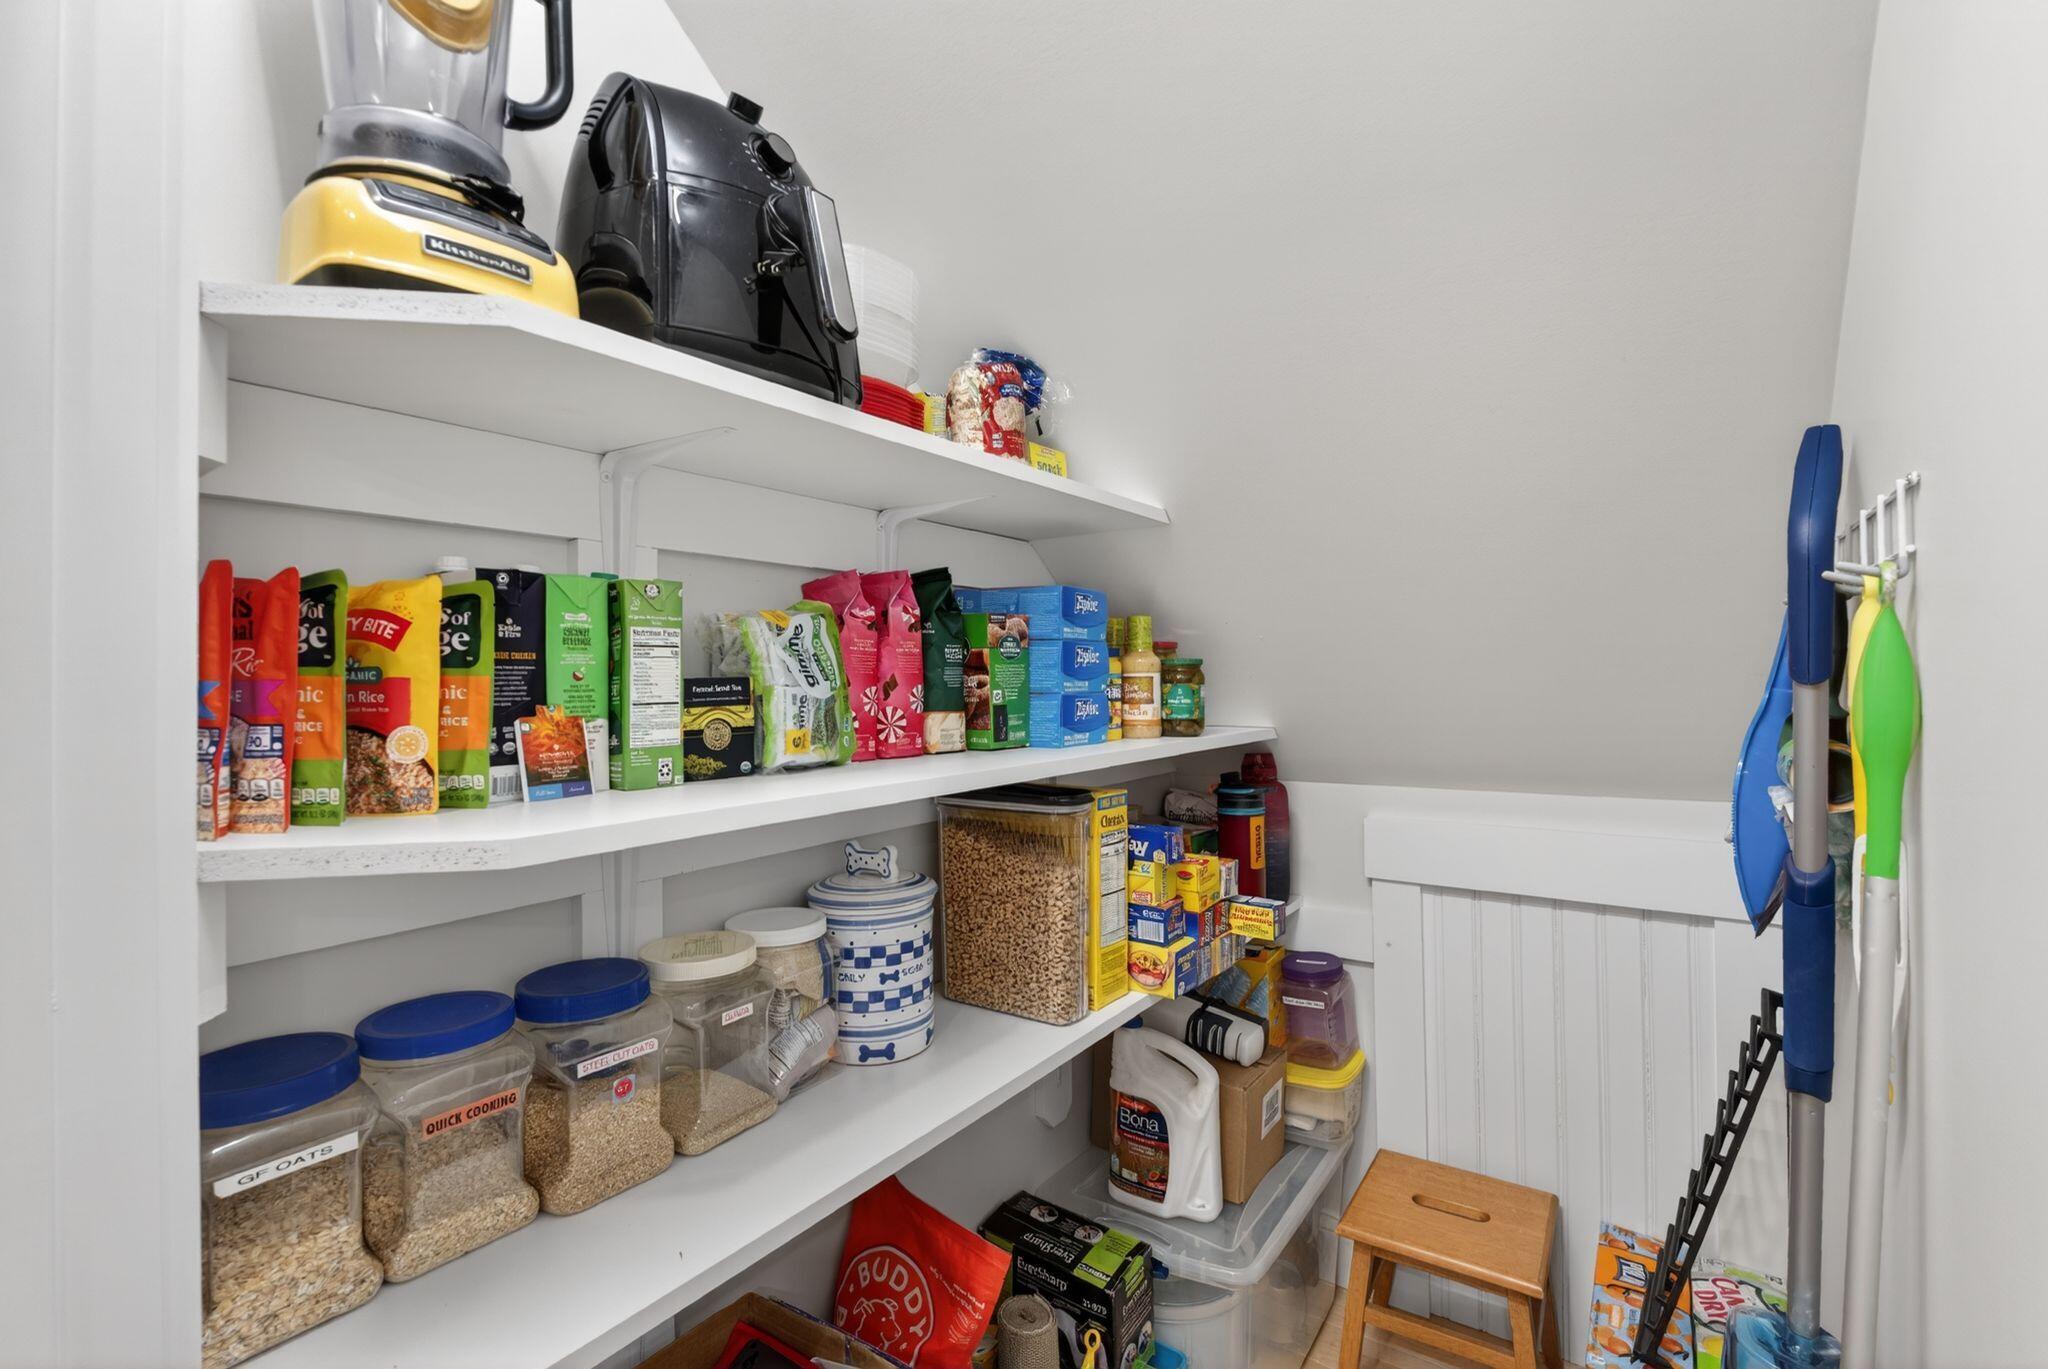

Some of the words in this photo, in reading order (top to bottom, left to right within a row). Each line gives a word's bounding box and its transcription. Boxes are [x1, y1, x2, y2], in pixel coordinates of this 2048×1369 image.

[430, 239, 527, 276] KitchenAid
[362, 618, 400, 639] BITE
[358, 691, 385, 704] Rice
[582, 1058, 609, 1073] STEEL
[612, 1048, 630, 1062] CUT
[632, 1040, 655, 1055] OATS
[425, 1111, 462, 1135] QUICK
[466, 1092, 517, 1120] COOKING
[1119, 1107, 1160, 1132] Bona
[236, 1168, 270, 1187] GF
[275, 1144, 334, 1171] OATS
[858, 1257, 927, 1337] BUDDY
[1694, 1289, 1729, 1323] DRY
